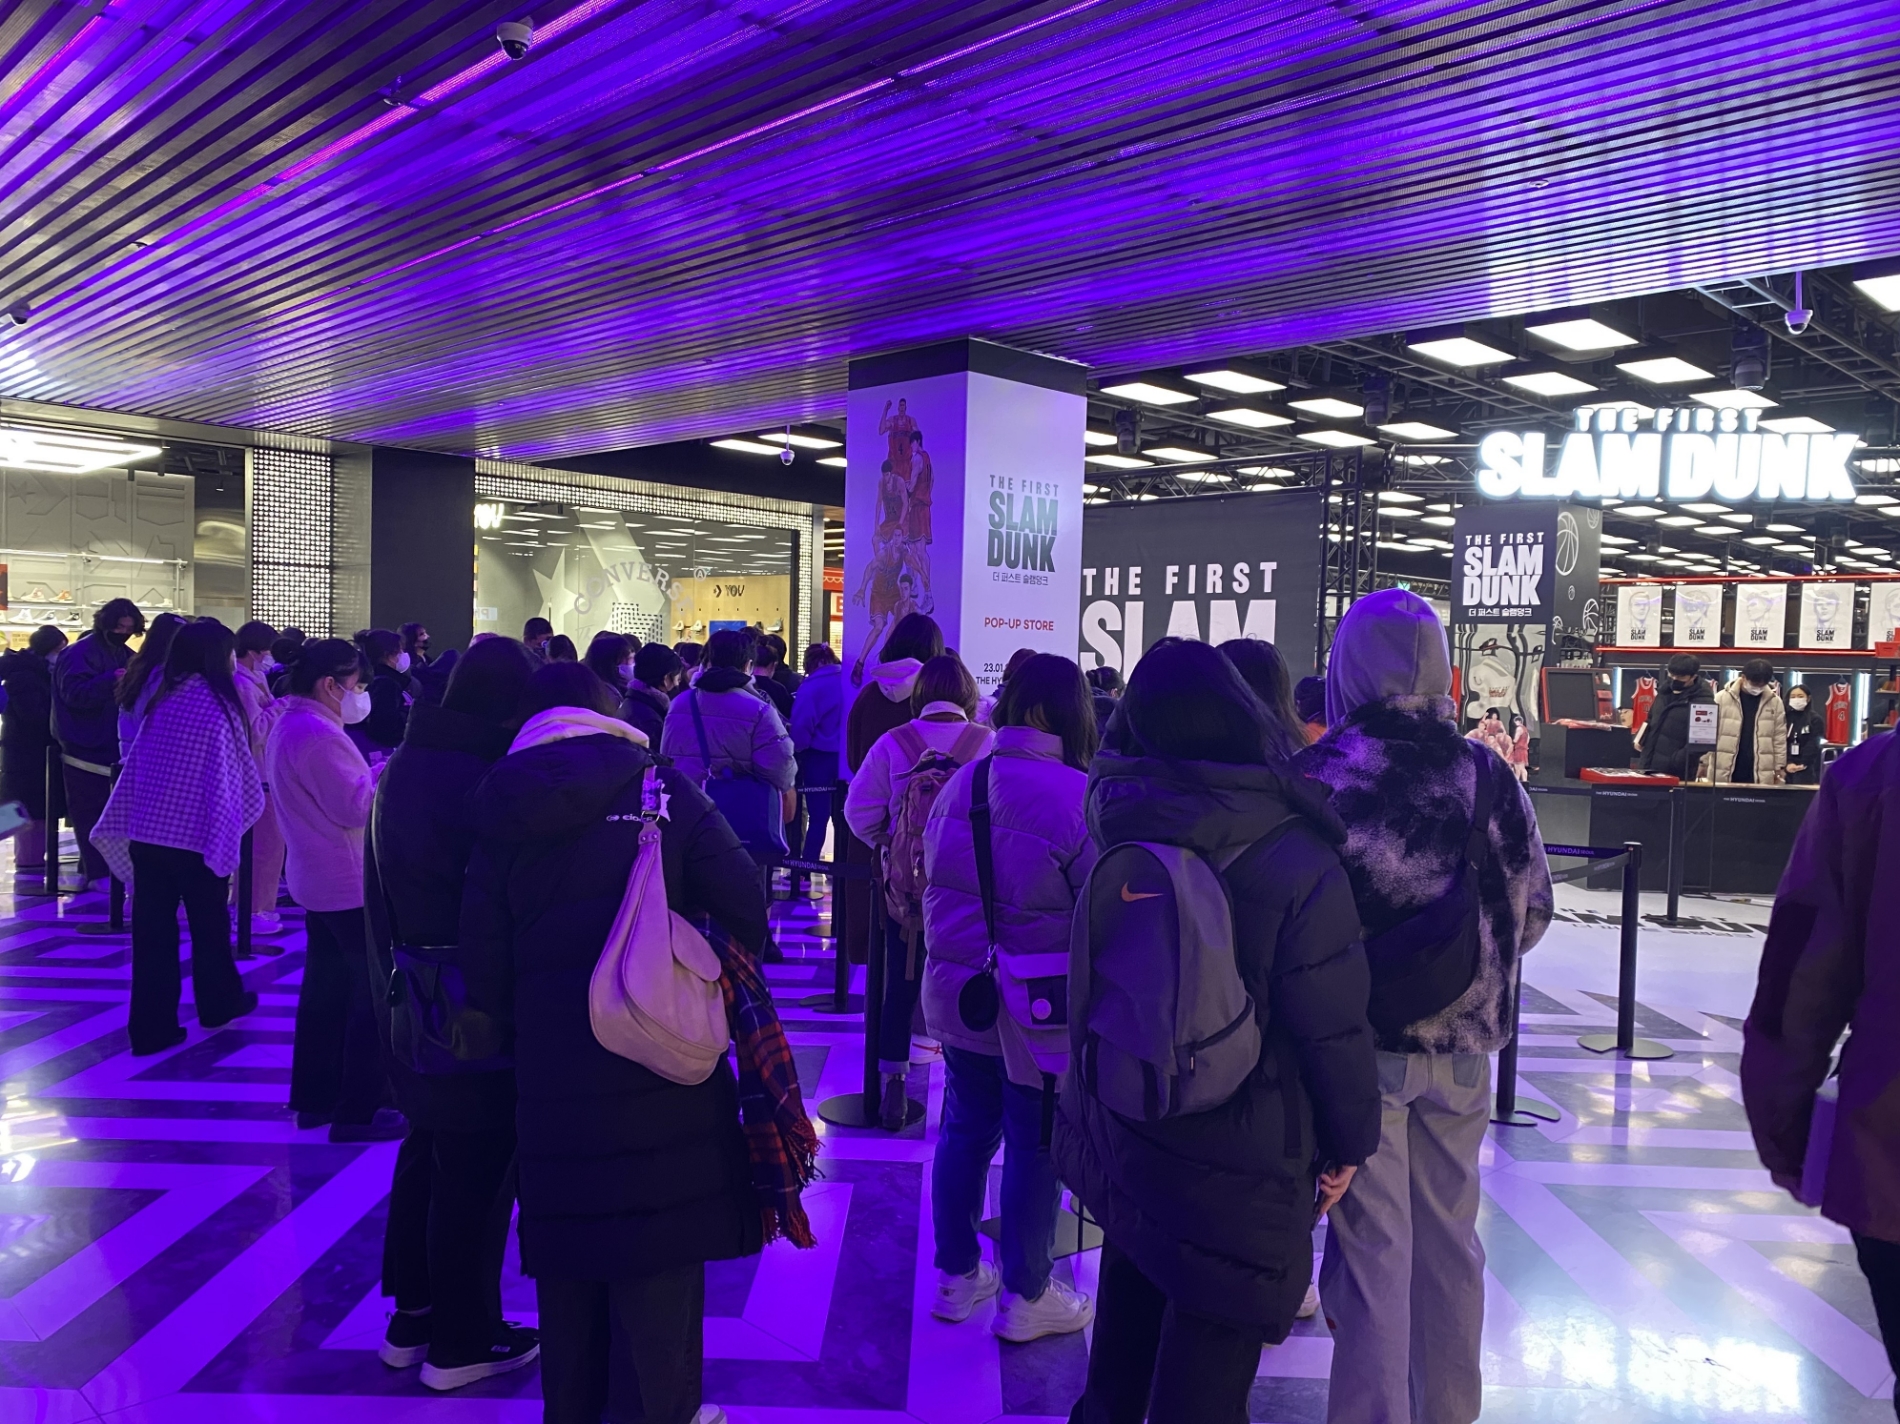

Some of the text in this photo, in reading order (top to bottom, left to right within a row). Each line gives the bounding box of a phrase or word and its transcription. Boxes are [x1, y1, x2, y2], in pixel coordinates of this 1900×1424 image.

[1574, 407, 1763, 433] THE FIRST
[1477, 431, 1860, 500] SLAM DUNK
[990, 474, 1059, 497] THE FIRST
[988, 490, 1059, 536] SLAM
[1465, 531, 1544, 546] THE FIRST
[987, 529, 1056, 573] DUNK
[1463, 544, 1544, 577] SLAM
[1083, 561, 1278, 596] THE FIRST
[1462, 575, 1541, 606] DUNK
[984, 617, 1054, 631] POP-UP STORE
[1468, 608, 1477, 617] 더
[976, 676, 991, 685] THE
[1548, 846, 1580, 854] HYUNDAI
[790, 860, 817, 869] HYUNDAI
